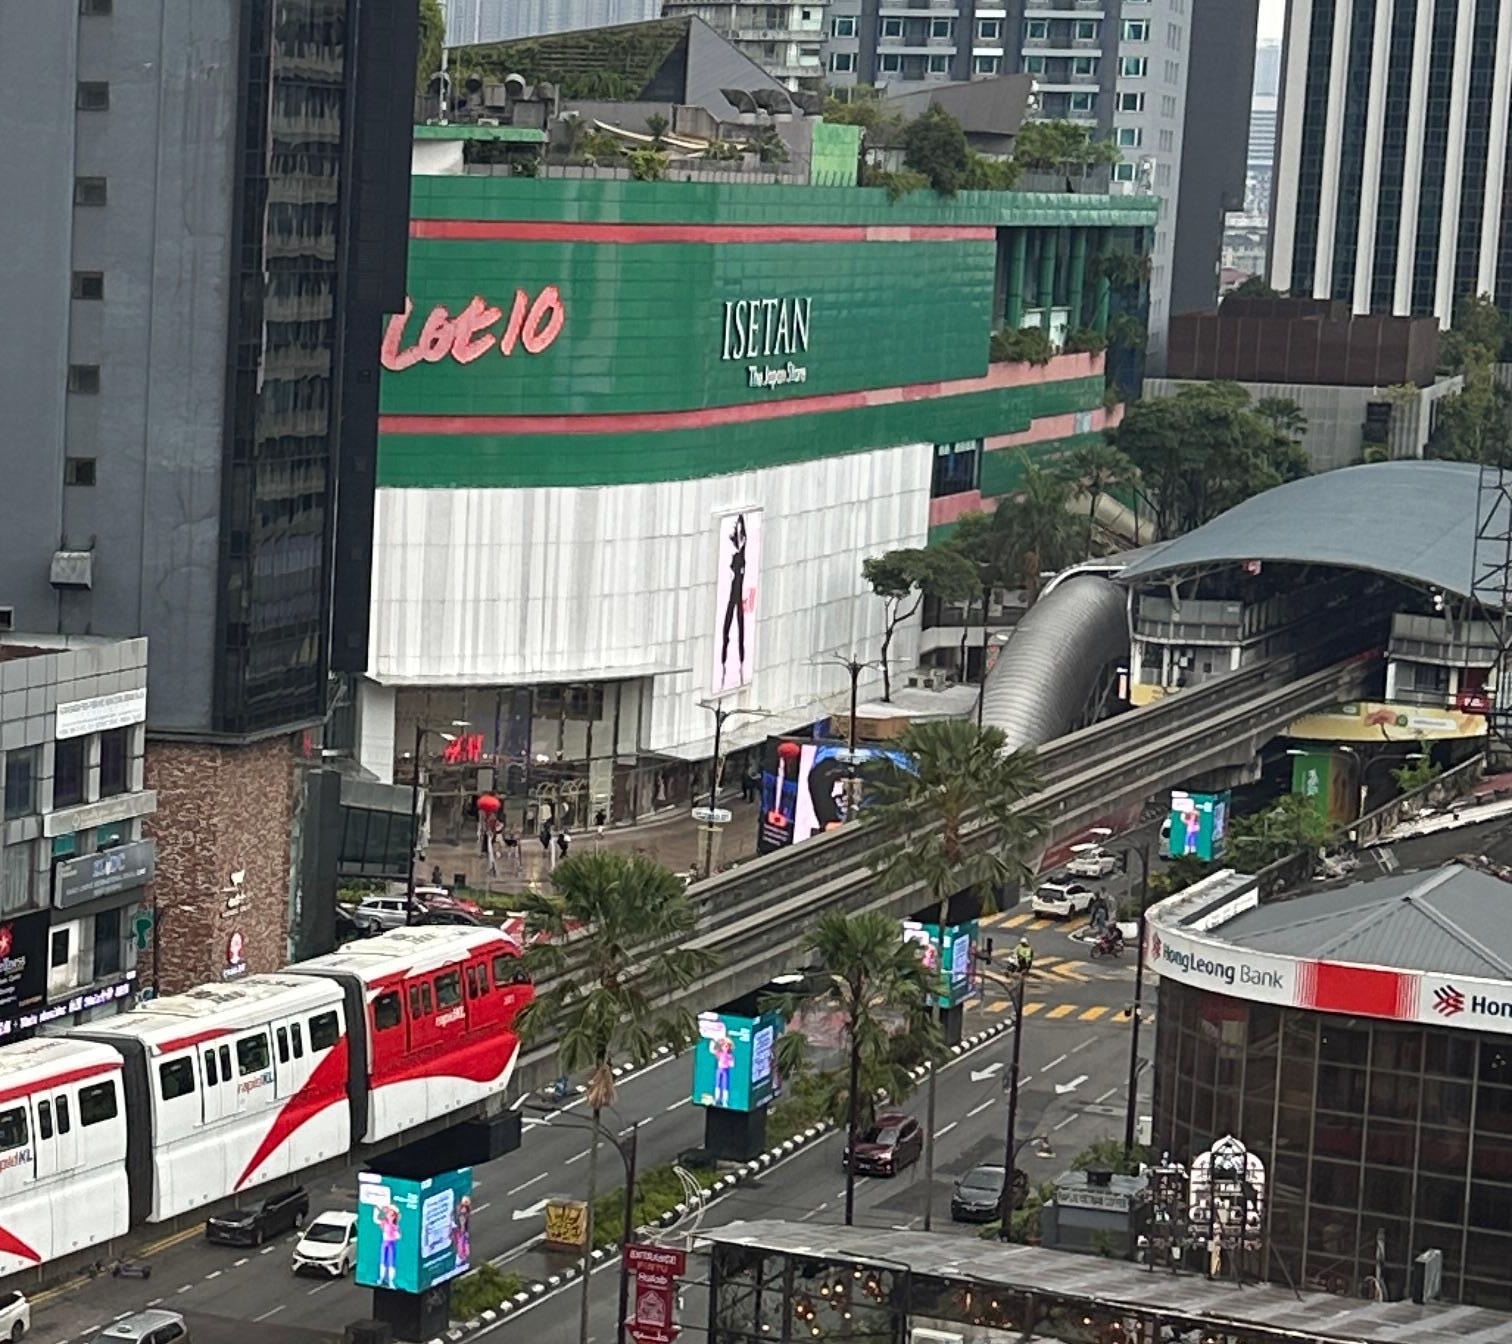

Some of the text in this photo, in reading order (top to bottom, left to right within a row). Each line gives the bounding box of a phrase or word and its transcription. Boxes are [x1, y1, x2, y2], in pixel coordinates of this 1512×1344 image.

[501, 284, 565, 356] 10
[722, 297, 812, 360] ISETAN
[1240, 964, 1284, 989] Bank
